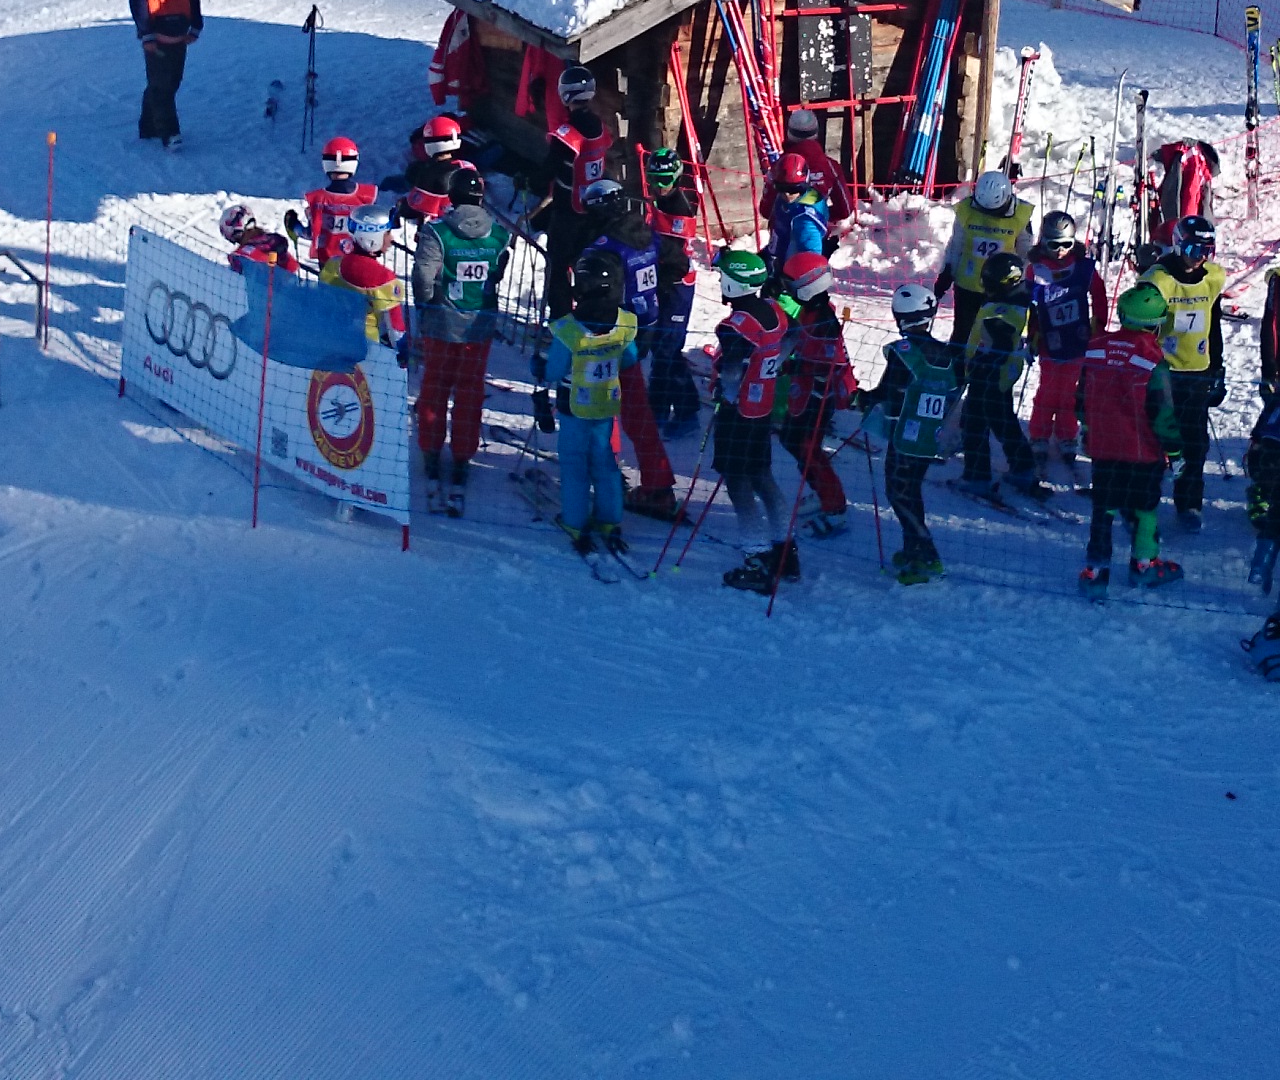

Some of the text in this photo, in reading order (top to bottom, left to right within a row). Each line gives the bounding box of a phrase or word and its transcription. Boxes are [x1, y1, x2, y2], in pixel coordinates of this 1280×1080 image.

[977, 241, 999, 257] 42
[463, 265, 484, 280] 40
[642, 269, 655, 287] 46
[1186, 313, 1197, 330] 7
[593, 361, 612, 379] 41
[925, 396, 941, 416] 10
